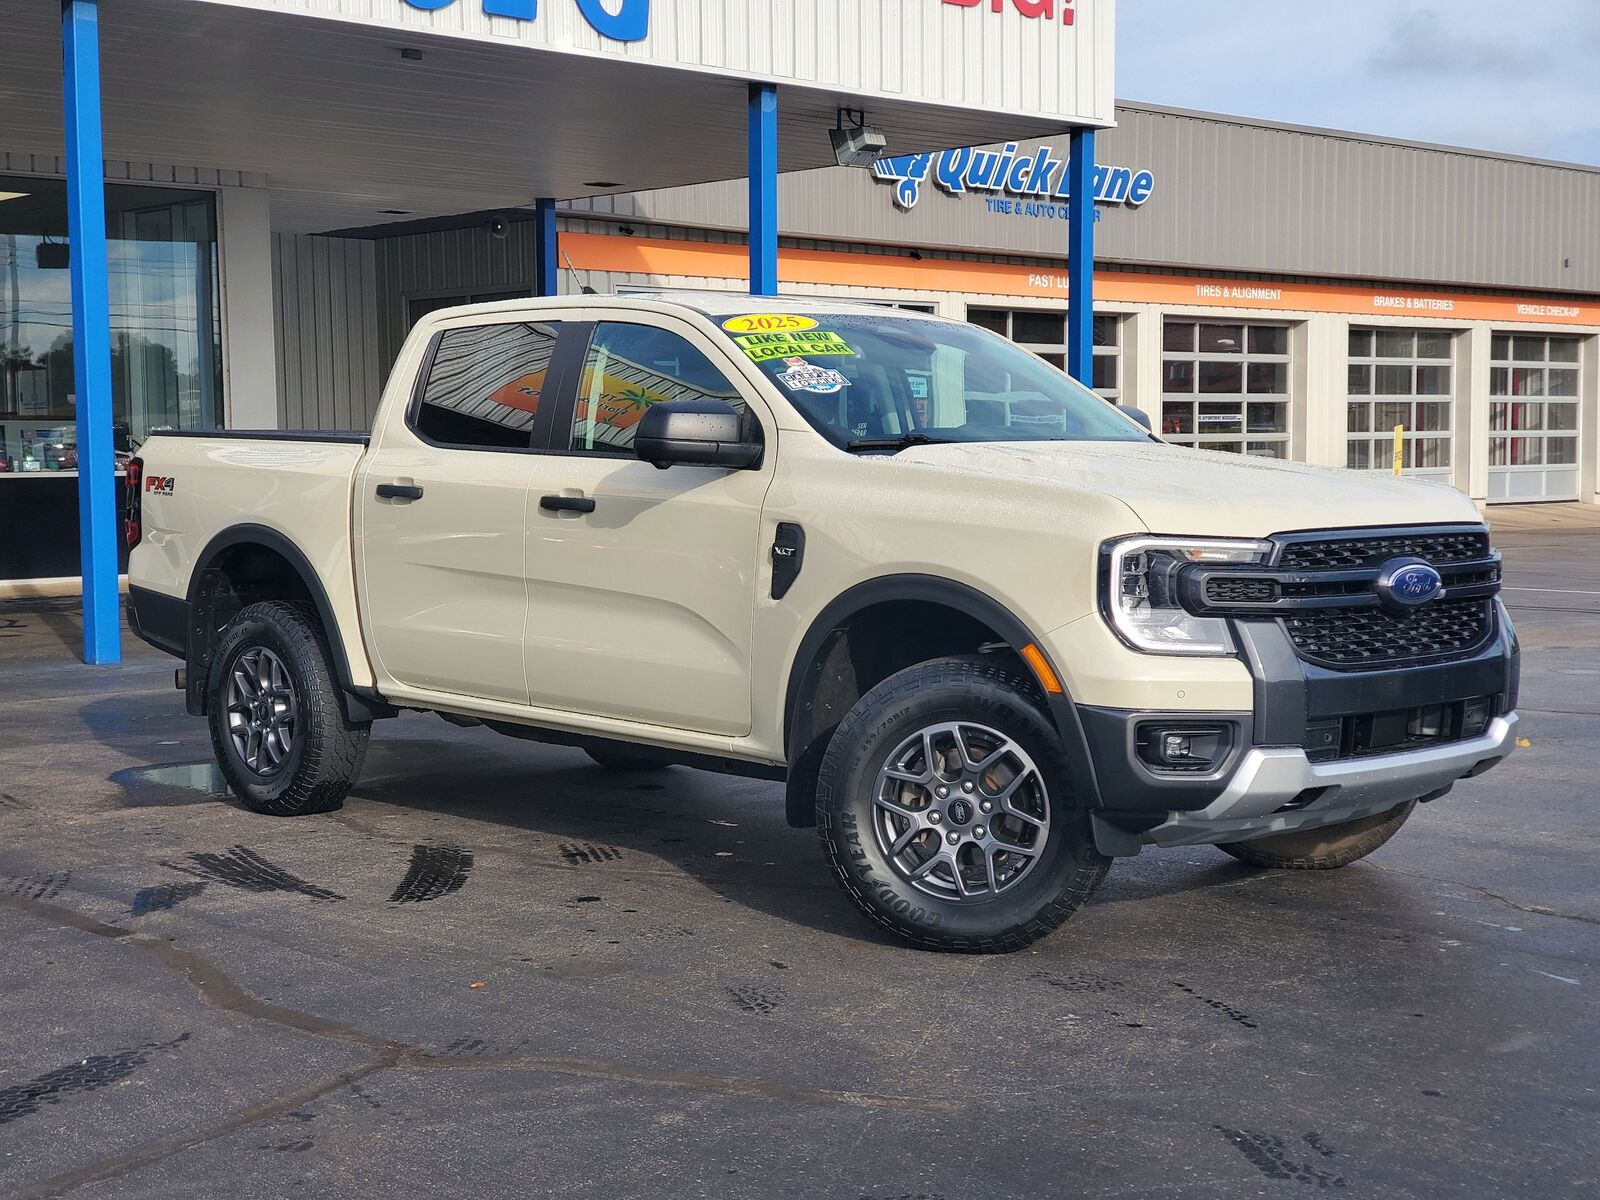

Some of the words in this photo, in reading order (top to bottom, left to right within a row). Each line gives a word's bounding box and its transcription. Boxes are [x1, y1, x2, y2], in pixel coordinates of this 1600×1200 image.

[936, 142, 1061, 194] Quick
[987, 198, 1013, 214] TIRE
[1014, 200, 1022, 215] &
[1025, 202, 1056, 218] AUTO
[1029, 273, 1055, 287] FAST
[1057, 276, 1070, 288] LU
[1195, 285, 1222, 297] TIRES
[1223, 286, 1230, 298] &
[1231, 287, 1282, 300] ALIGNMENT
[1374, 296, 1405, 308] BRAKES
[1406, 298, 1412, 308] &
[1413, 299, 1454, 310] BATTERIES
[1517, 304, 1545, 315] VEHICLE
[1546, 306, 1580, 317] CHECK-UP
[741, 316, 801, 331] 2025
[744, 333, 787, 346] LIKE
[789, 332, 830, 342] NEW
[749, 345, 811, 359] LOCAL
[814, 343, 849, 353] CAR
[145, 476, 175, 492] FX4
[1402, 572, 1432, 593] Ford
